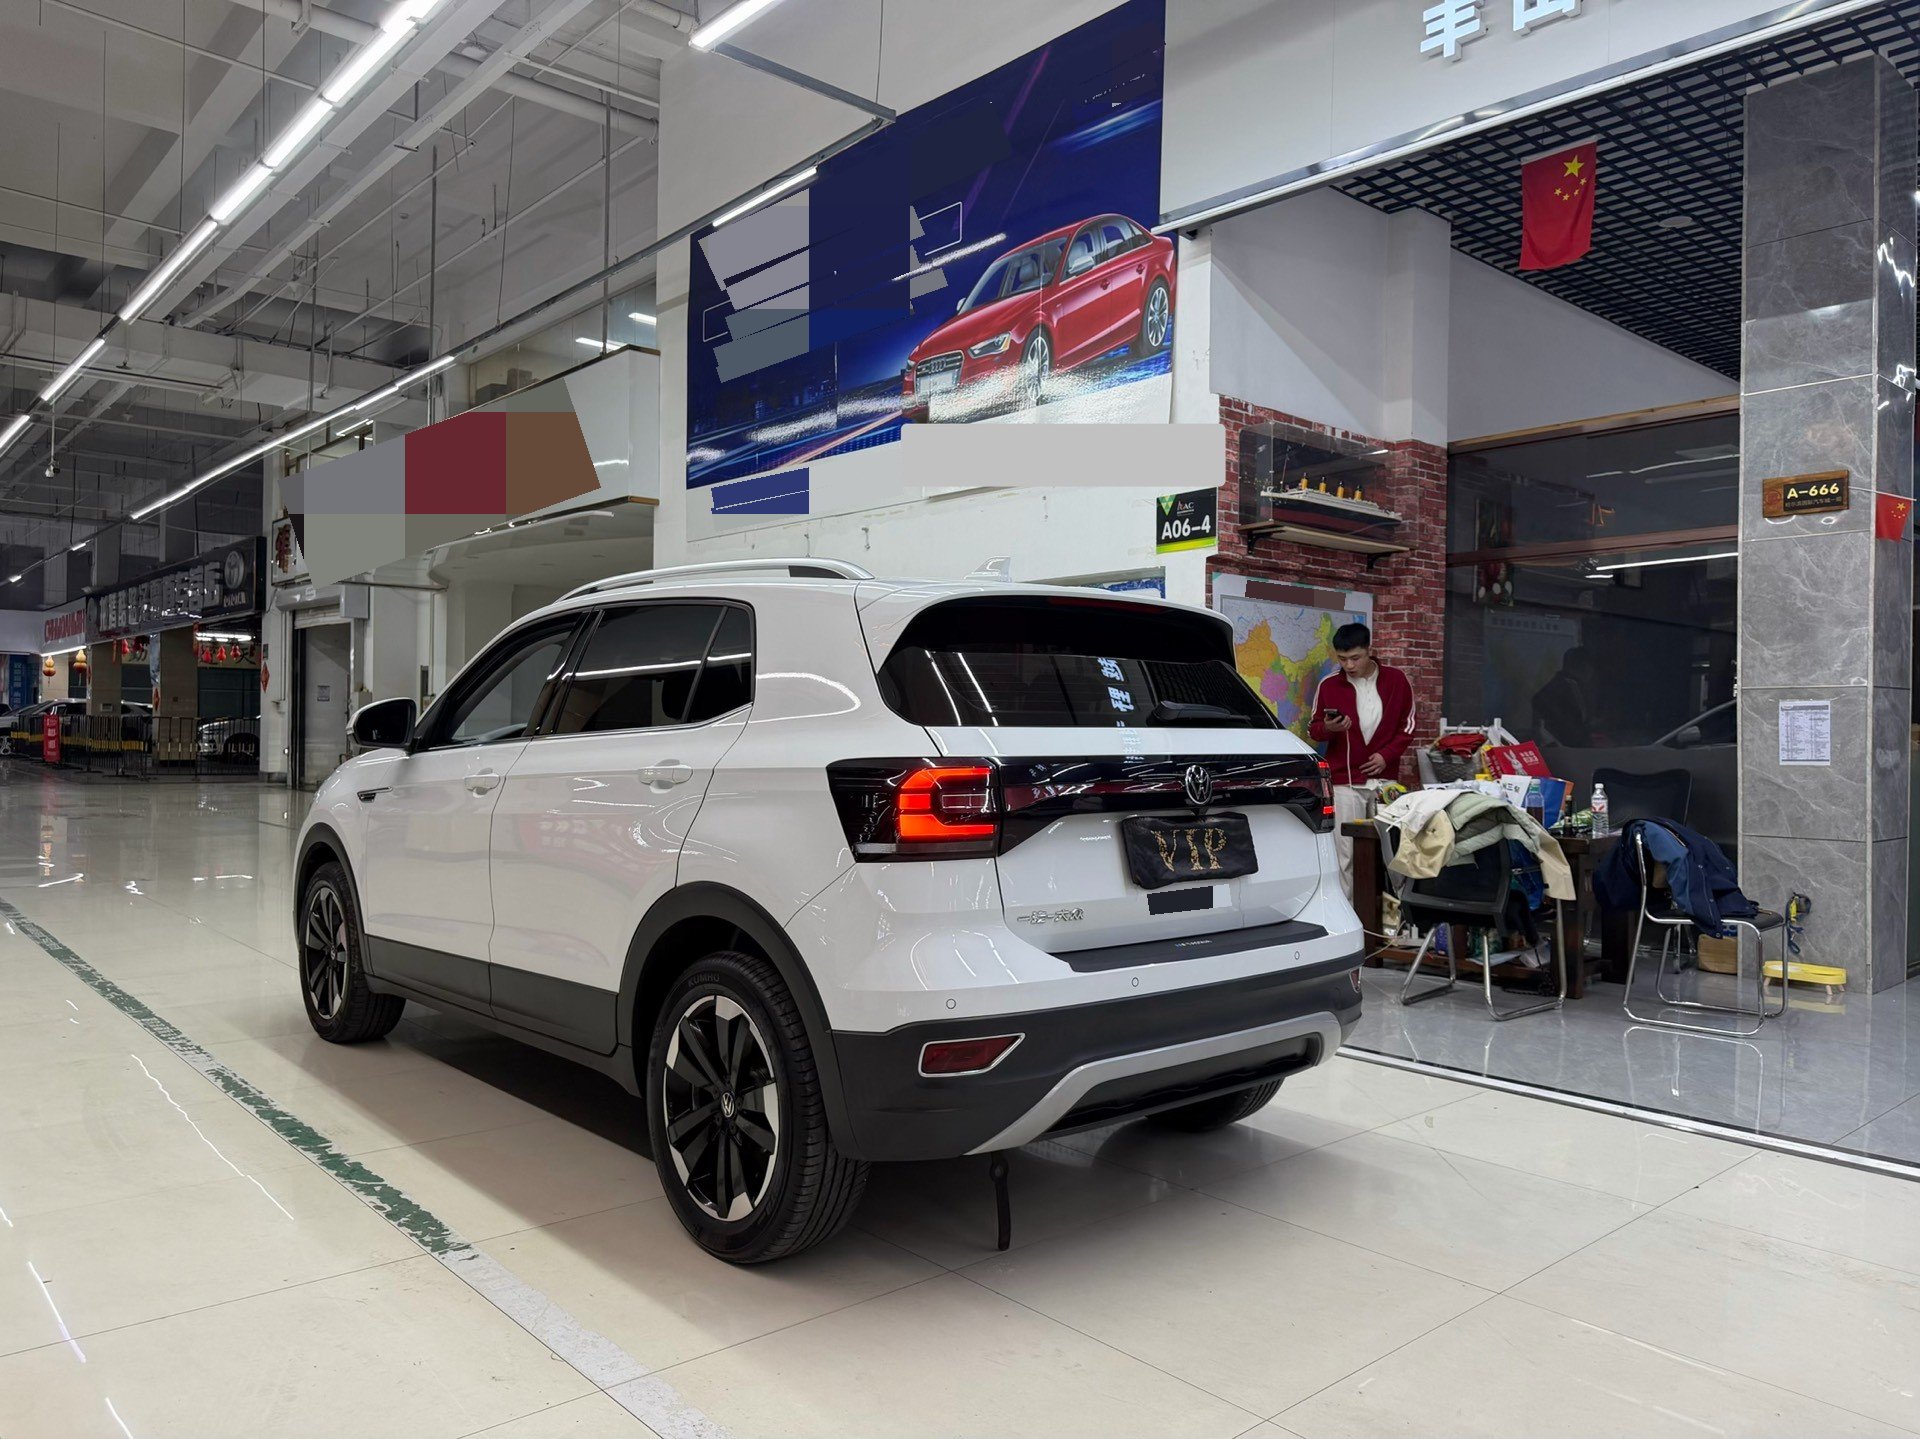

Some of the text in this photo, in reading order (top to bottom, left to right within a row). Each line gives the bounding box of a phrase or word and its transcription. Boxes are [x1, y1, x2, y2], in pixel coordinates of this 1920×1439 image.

[1786, 483, 1840, 499] A-666
[1161, 514, 1211, 540] A06-4
[1150, 827, 1228, 872] VIP
